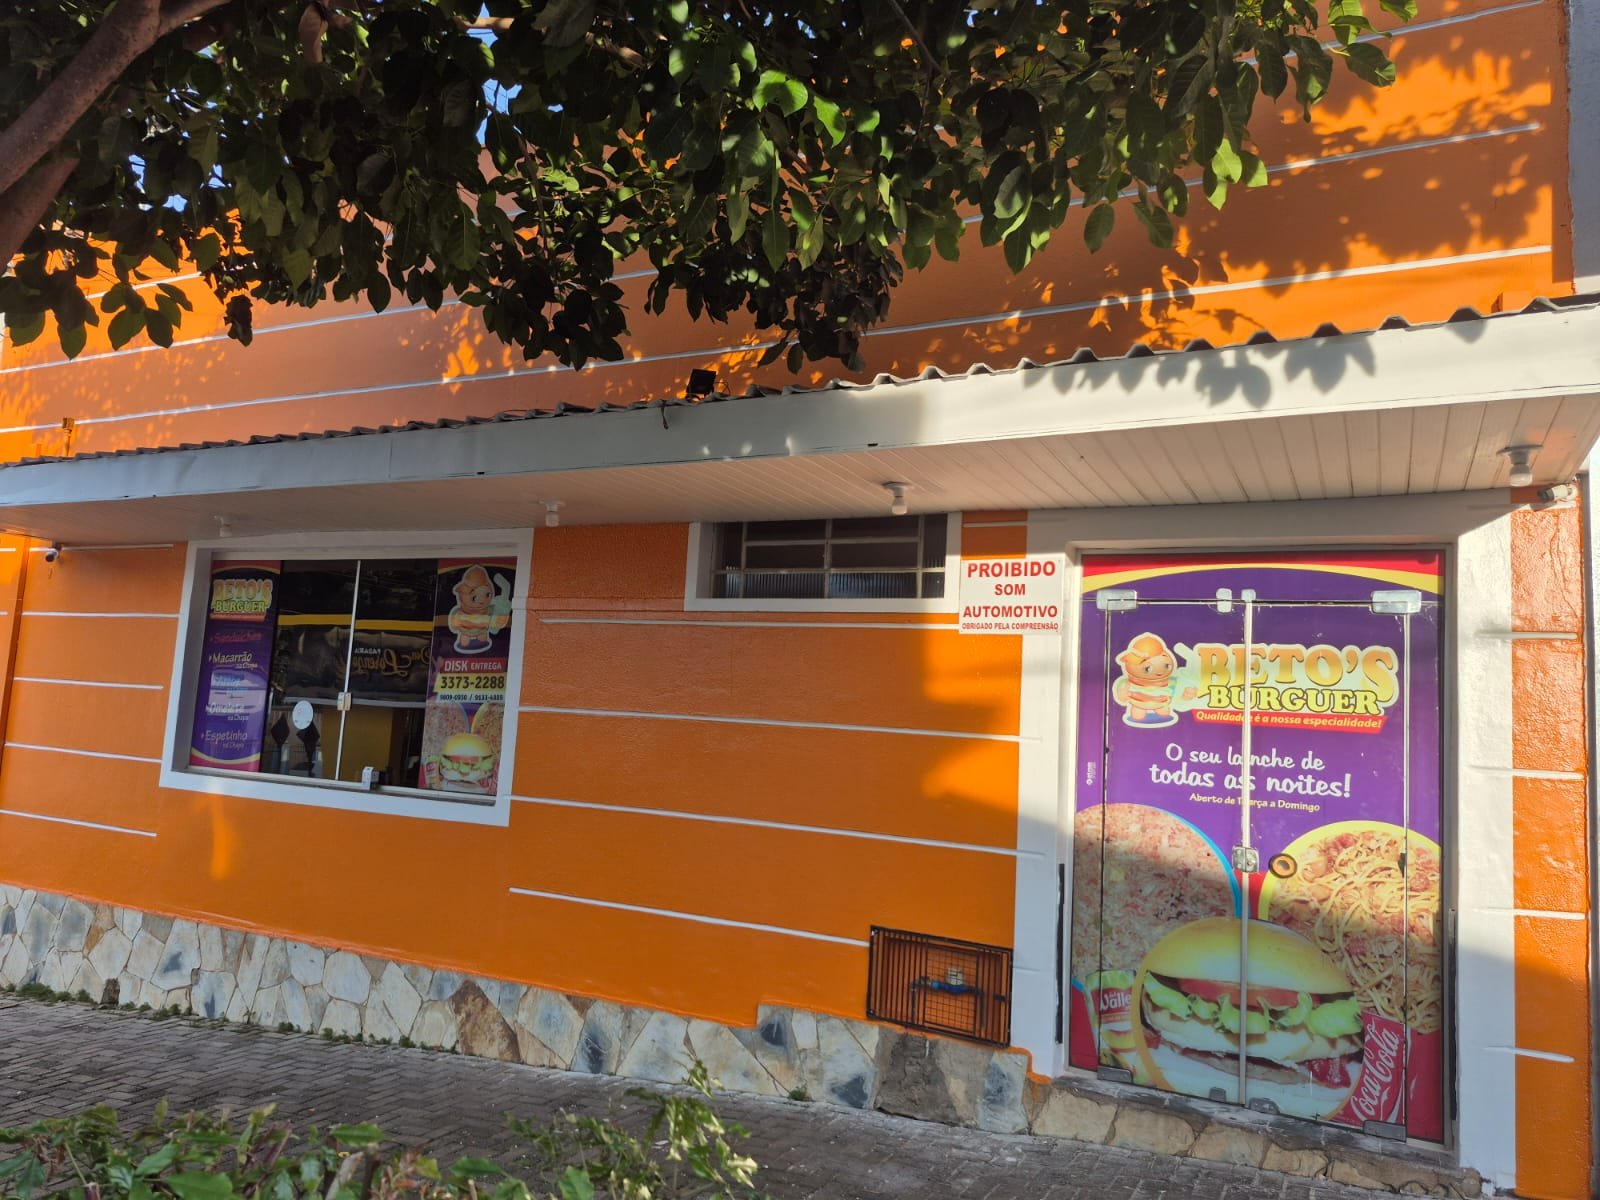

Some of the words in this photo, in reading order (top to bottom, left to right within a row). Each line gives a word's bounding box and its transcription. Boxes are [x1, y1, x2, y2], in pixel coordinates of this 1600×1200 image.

[967, 560, 1056, 578] PROIBIDO
[994, 583, 1026, 596] SOM
[214, 600, 266, 613] BURGUER
[963, 605, 1058, 618] AUTOMOTIVO
[962, 622, 993, 630] OBRIGADO
[994, 622, 1010, 630] PELA
[1011, 621, 1059, 631] COMPREENSÃO
[444, 660, 468, 672] DISK
[470, 662, 502, 670] ENTREGA
[440, 675, 505, 689] 3373-2288
[1198, 647, 1395, 703] BETO'S
[1208, 685, 1382, 715] BURGUER
[1254, 713, 1261, 723] é
[1270, 716, 1301, 726] nossa
[1303, 715, 1382, 728] especialidade!
[1165, 742, 1183, 762] O
[1189, 750, 1222, 765] seu
[1227, 746, 1296, 769] lanche
[1301, 751, 1326, 771] de
[1149, 761, 1215, 788] todas
[1224, 774, 1256, 791] as
[1266, 773, 1352, 799] noites!
[1189, 792, 1224, 804] Aberto
[1224, 796, 1236, 806] de
[1269, 800, 1276, 808] a
[1277, 800, 1321, 813] Domingo
